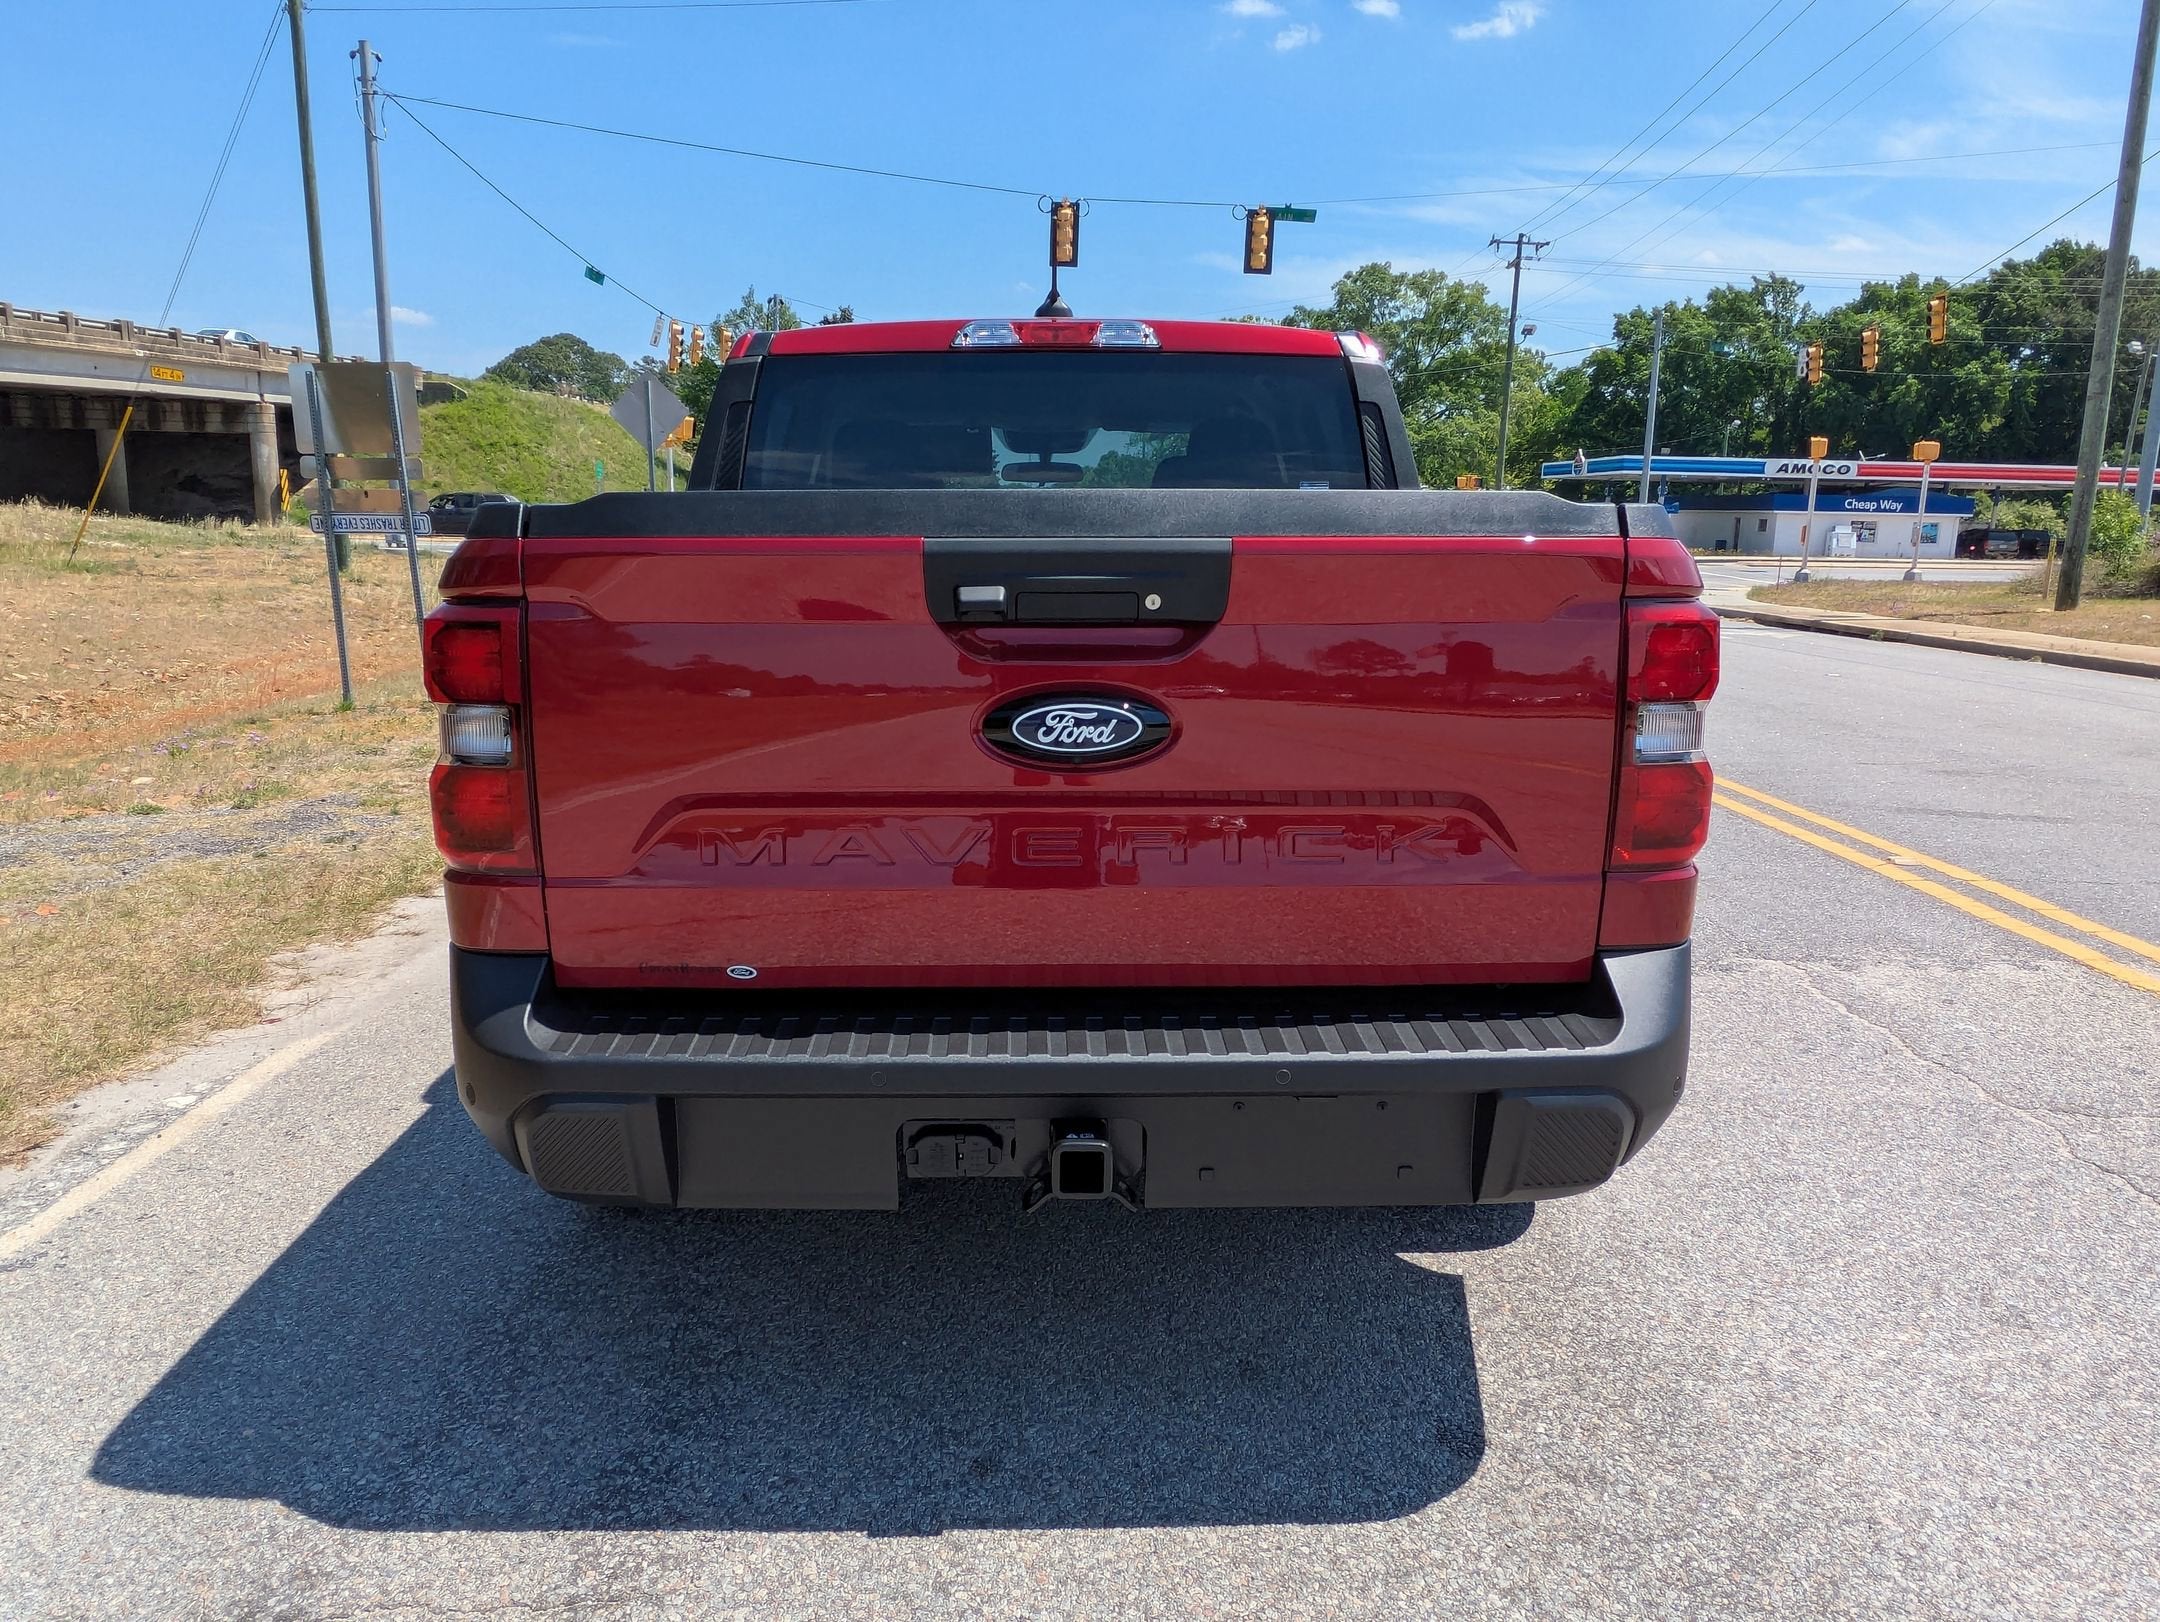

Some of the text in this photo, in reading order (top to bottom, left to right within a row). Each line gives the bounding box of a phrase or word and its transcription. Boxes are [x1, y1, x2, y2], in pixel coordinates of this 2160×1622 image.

[1776, 463, 1851, 475] AMOCO
[1844, 499, 1903, 512] Cheap Way
[314, 517, 427, 531] LITR TRASHES EVERYNE
[1037, 710, 1118, 743] Ford
[697, 824, 1449, 867] MAVERICK
